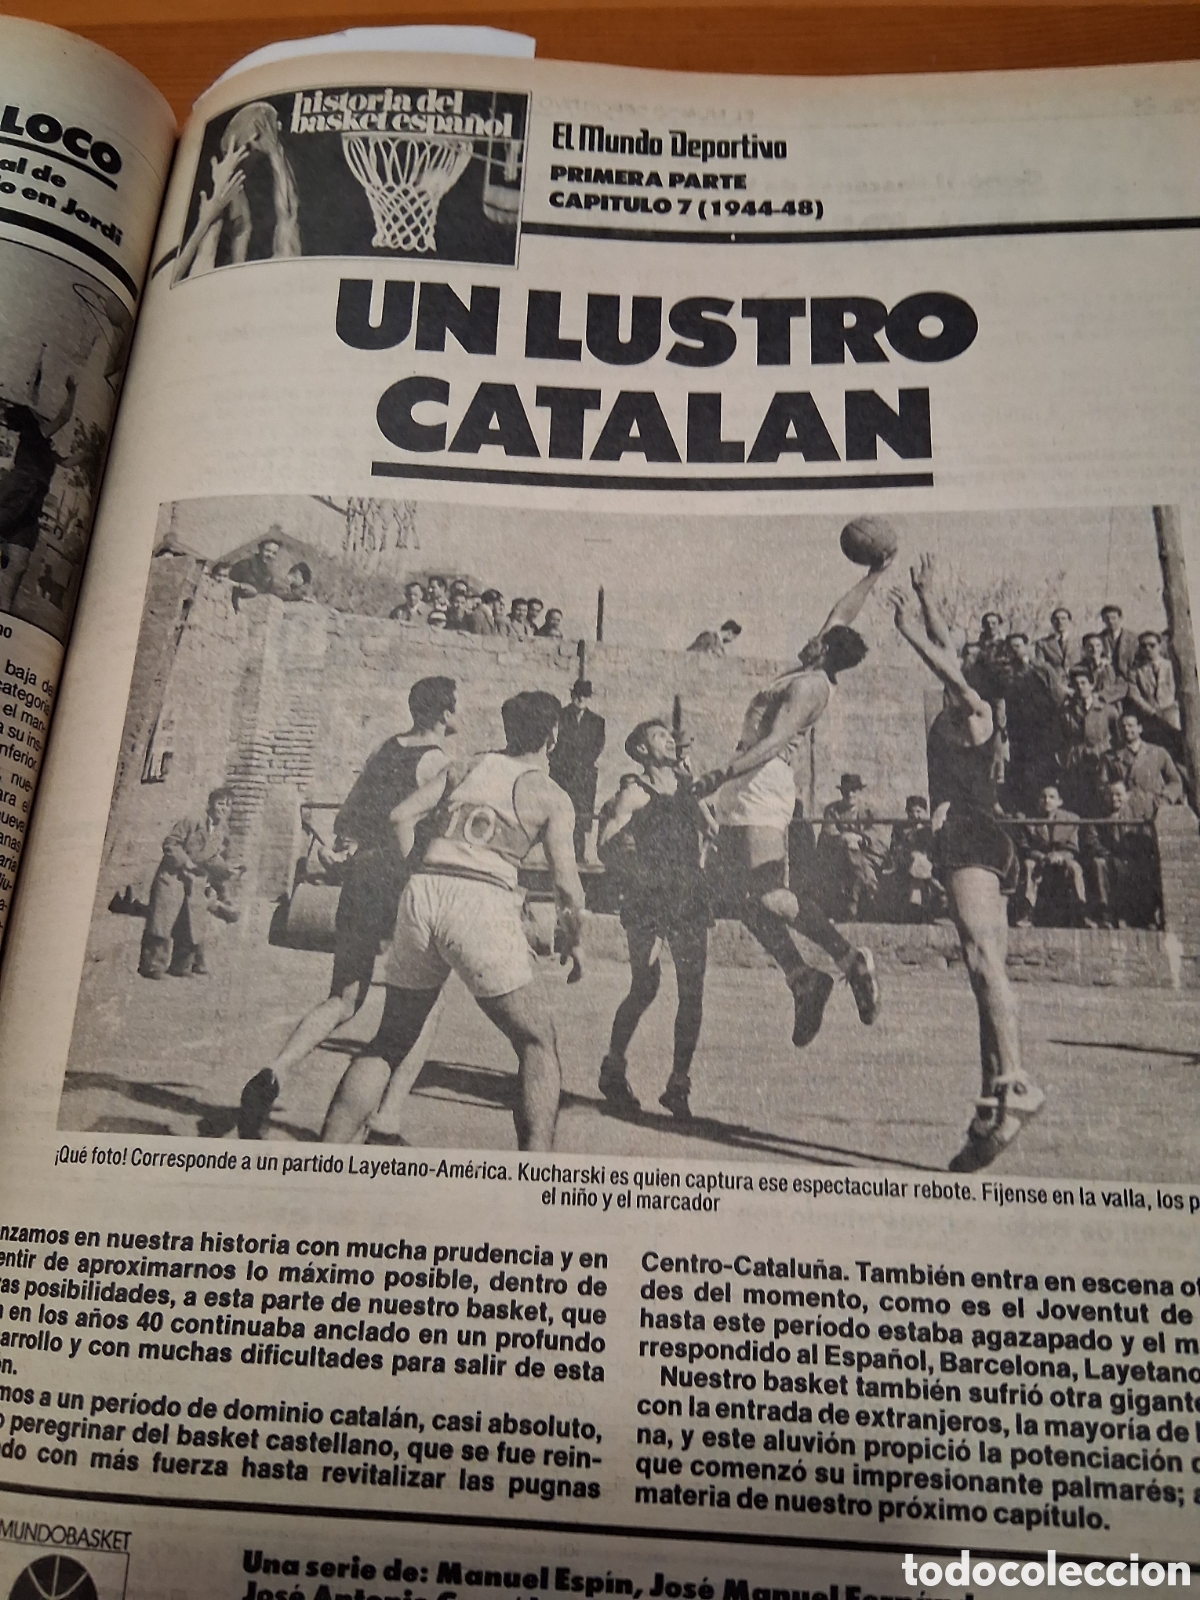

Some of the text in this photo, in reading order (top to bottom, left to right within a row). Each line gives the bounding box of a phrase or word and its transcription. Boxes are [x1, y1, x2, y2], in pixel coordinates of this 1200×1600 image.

[291, 109, 513, 137] basket español
[292, 88, 463, 114] historia del
[0, 105, 122, 175] LOCO
[552, 121, 787, 162] El Mundo Deportivo
[31, 165, 67, 188] de
[550, 165, 747, 190] PRIMERA PARTE
[21, 187, 124, 247] en Jordi
[549, 191, 824, 220] CAPITULO 7 (1944-48)
[336, 278, 979, 368] UN LUSTRO
[376, 375, 933, 464] CATALAN
[5, 659, 37, 686] baja
[3, 704, 18, 718] el
[8, 725, 25, 742] su
[54, 1145, 1184, 1211] ¡Qué foto! Corresponde a un partido Layetano-América. Kucharski es quien captura ese espectacular rebote. Fíjense en la valla, los
[542, 1187, 721, 1212] el niño y el marcador
[107, 1231, 194, 1252] nuestra
[201, 1232, 290, 1255] historia
[296, 1239, 340, 1257] con
[347, 1239, 427, 1261] mucha
[433, 1242, 554, 1266] prudencia
[77, 1256, 567, 1295] aproximarnos máximo posible, dentro
[641, 1251, 1174, 1296] Centro-Cataluña. También entra escena
[25, 1278, 607, 1328] posibilidades, esta parte nuestro basket, que
[640, 1279, 1149, 1323] des del momento, como Joventut
[39, 1304, 606, 1353] los años continuaba anclado profundo
[640, 1307, 1112, 1353] hasta este período estaba agazapado
[0, 1331, 605, 1382] arrollo con muchas dificultades para salir esta
[639, 1339, 1200, 1385] rrespondido Español, Barcelona, Layetano
[660, 1365, 1102, 1409] Nuestro basket también sufrió otra
[90, 1393, 602, 1444] período dominio catalán, casi absoluto,
[637, 1398, 1151, 1444] con entrada extranjeros, mayoría
[10, 1414, 602, 1469] peregrinar del basket castellano, que fue rein-
[637, 1428, 1183, 1473] na, este aluvión propició potenciación
[37, 1446, 601, 1501] con más fuerza hasta revitalizar las pugnas
[636, 1456, 1184, 1508] que comenzó impresionante palmarés;
[635, 1484, 1110, 1531] materia nuestro próximo capítulo.
[0, 1519, 132, 1550] MUNDOBASKET
[242, 1550, 299, 1575] Una
[305, 1555, 376, 1580] serie
[383, 1558, 428, 1583] de:
[436, 1561, 549, 1589] Manuel
[555, 1567, 643, 1599] Espín,
[650, 1571, 714, 1600] José
[723, 1578, 838, 1600] Manuel
